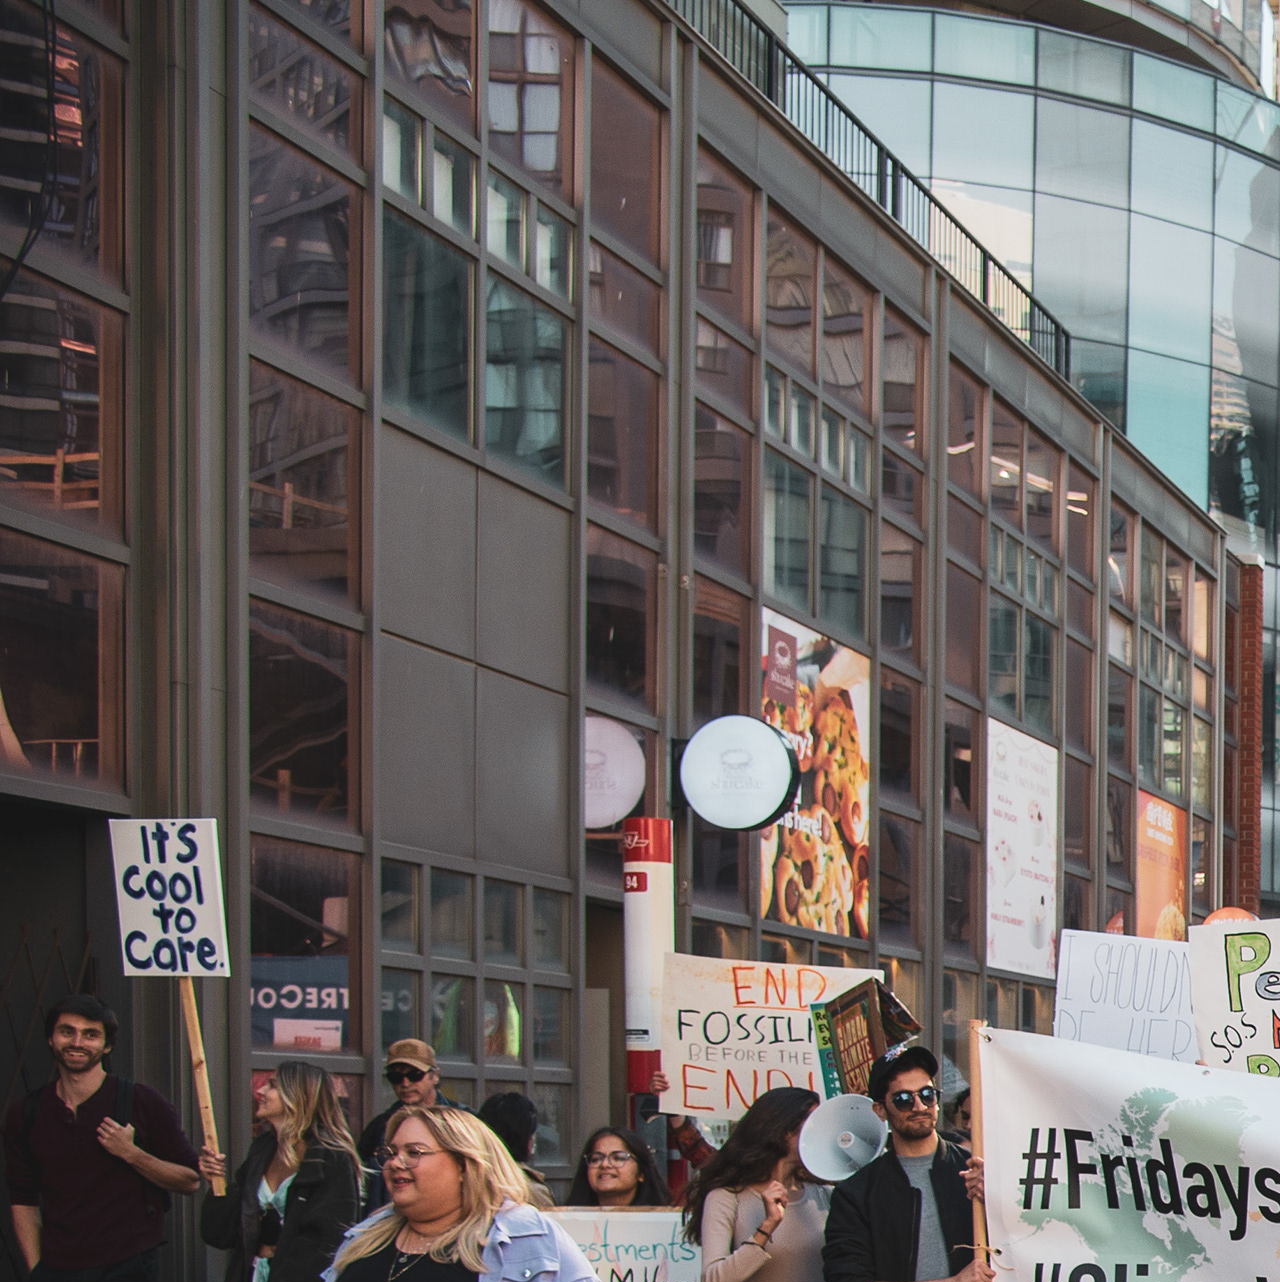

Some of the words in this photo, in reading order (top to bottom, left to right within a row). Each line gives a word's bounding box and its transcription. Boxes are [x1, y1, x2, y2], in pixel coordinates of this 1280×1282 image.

[625, 875, 639, 889] 94
[152, 902, 197, 934] to
[1062, 934, 1082, 1000] I
[731, 966, 827, 1008] END
[678, 1008, 805, 1045] FOSSIL
[688, 1043, 768, 1063] BEFORE
[779, 1049, 814, 1066] THE
